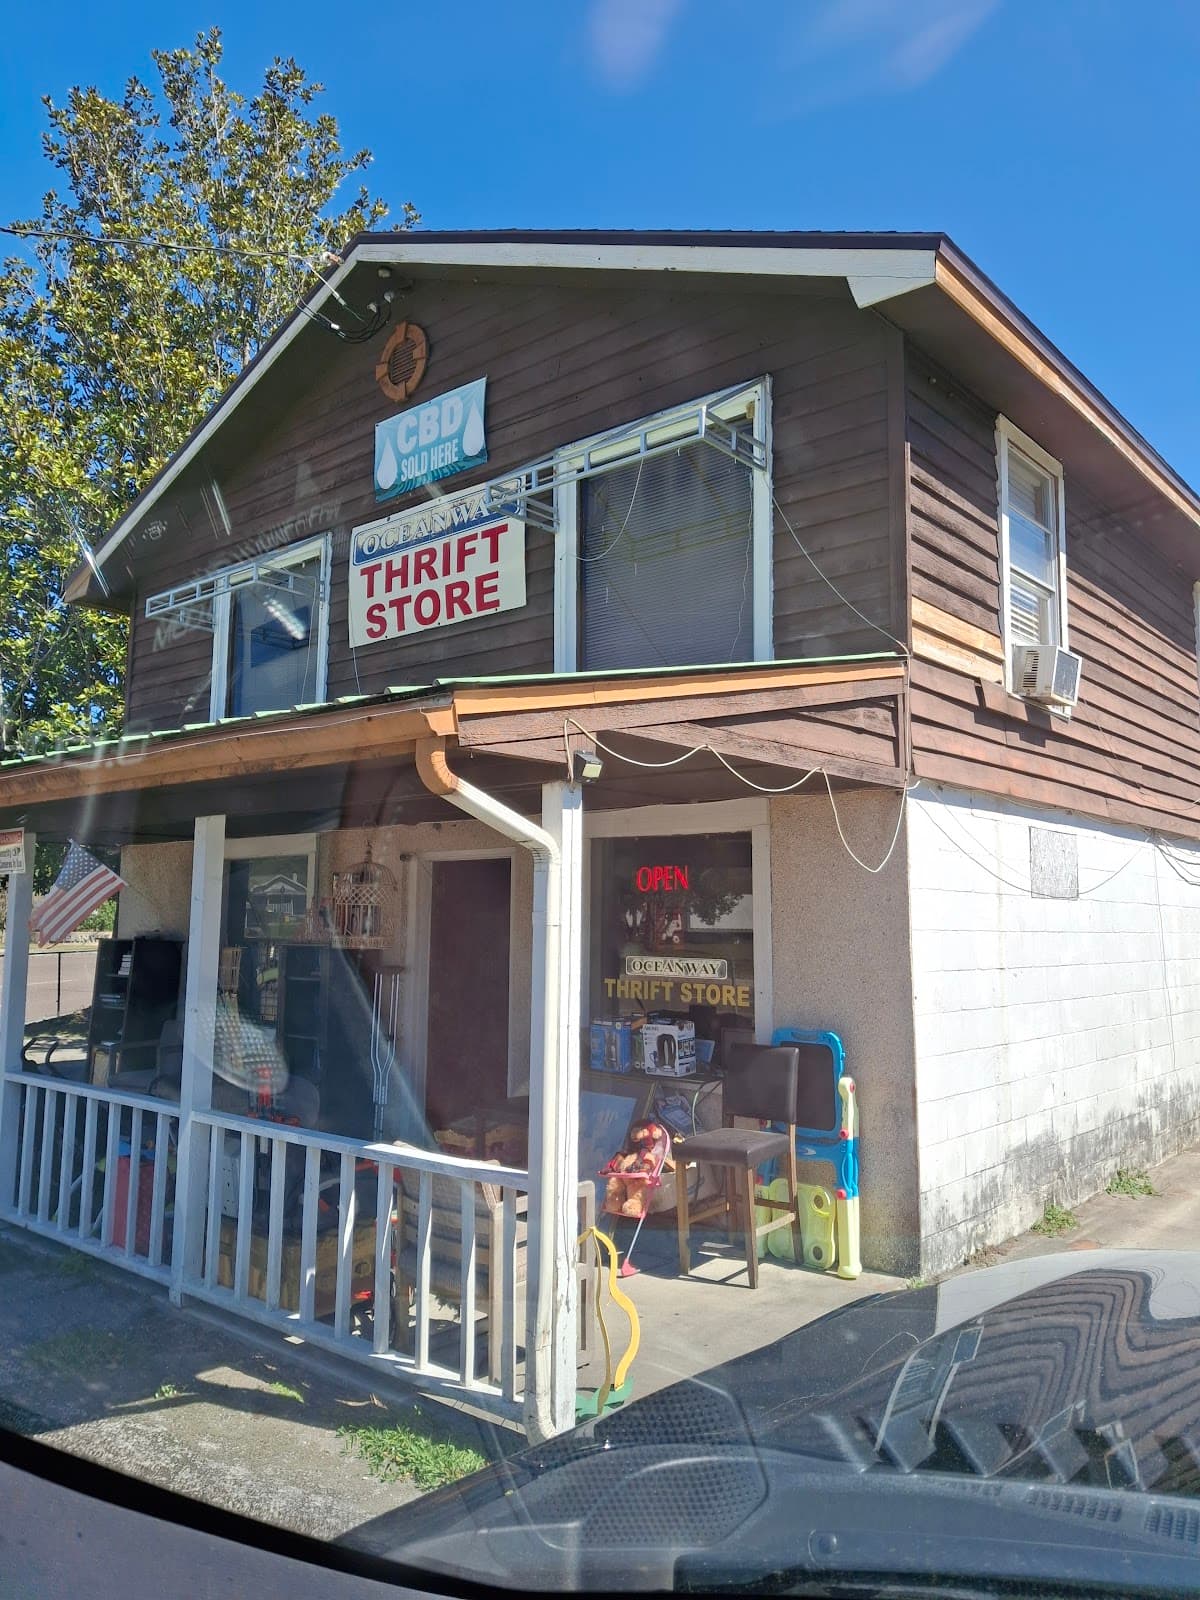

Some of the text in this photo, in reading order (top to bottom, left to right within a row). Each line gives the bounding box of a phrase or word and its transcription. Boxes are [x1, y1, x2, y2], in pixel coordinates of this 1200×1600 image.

[397, 396, 464, 454] CBD
[401, 438, 459, 482] SOLD HERE
[360, 523, 509, 599] THRIFT
[365, 571, 501, 639] STORE
[636, 865, 689, 892] OPEN
[632, 959, 720, 976] OCEANWAY
[604, 978, 750, 1007] THRIFT STORE
